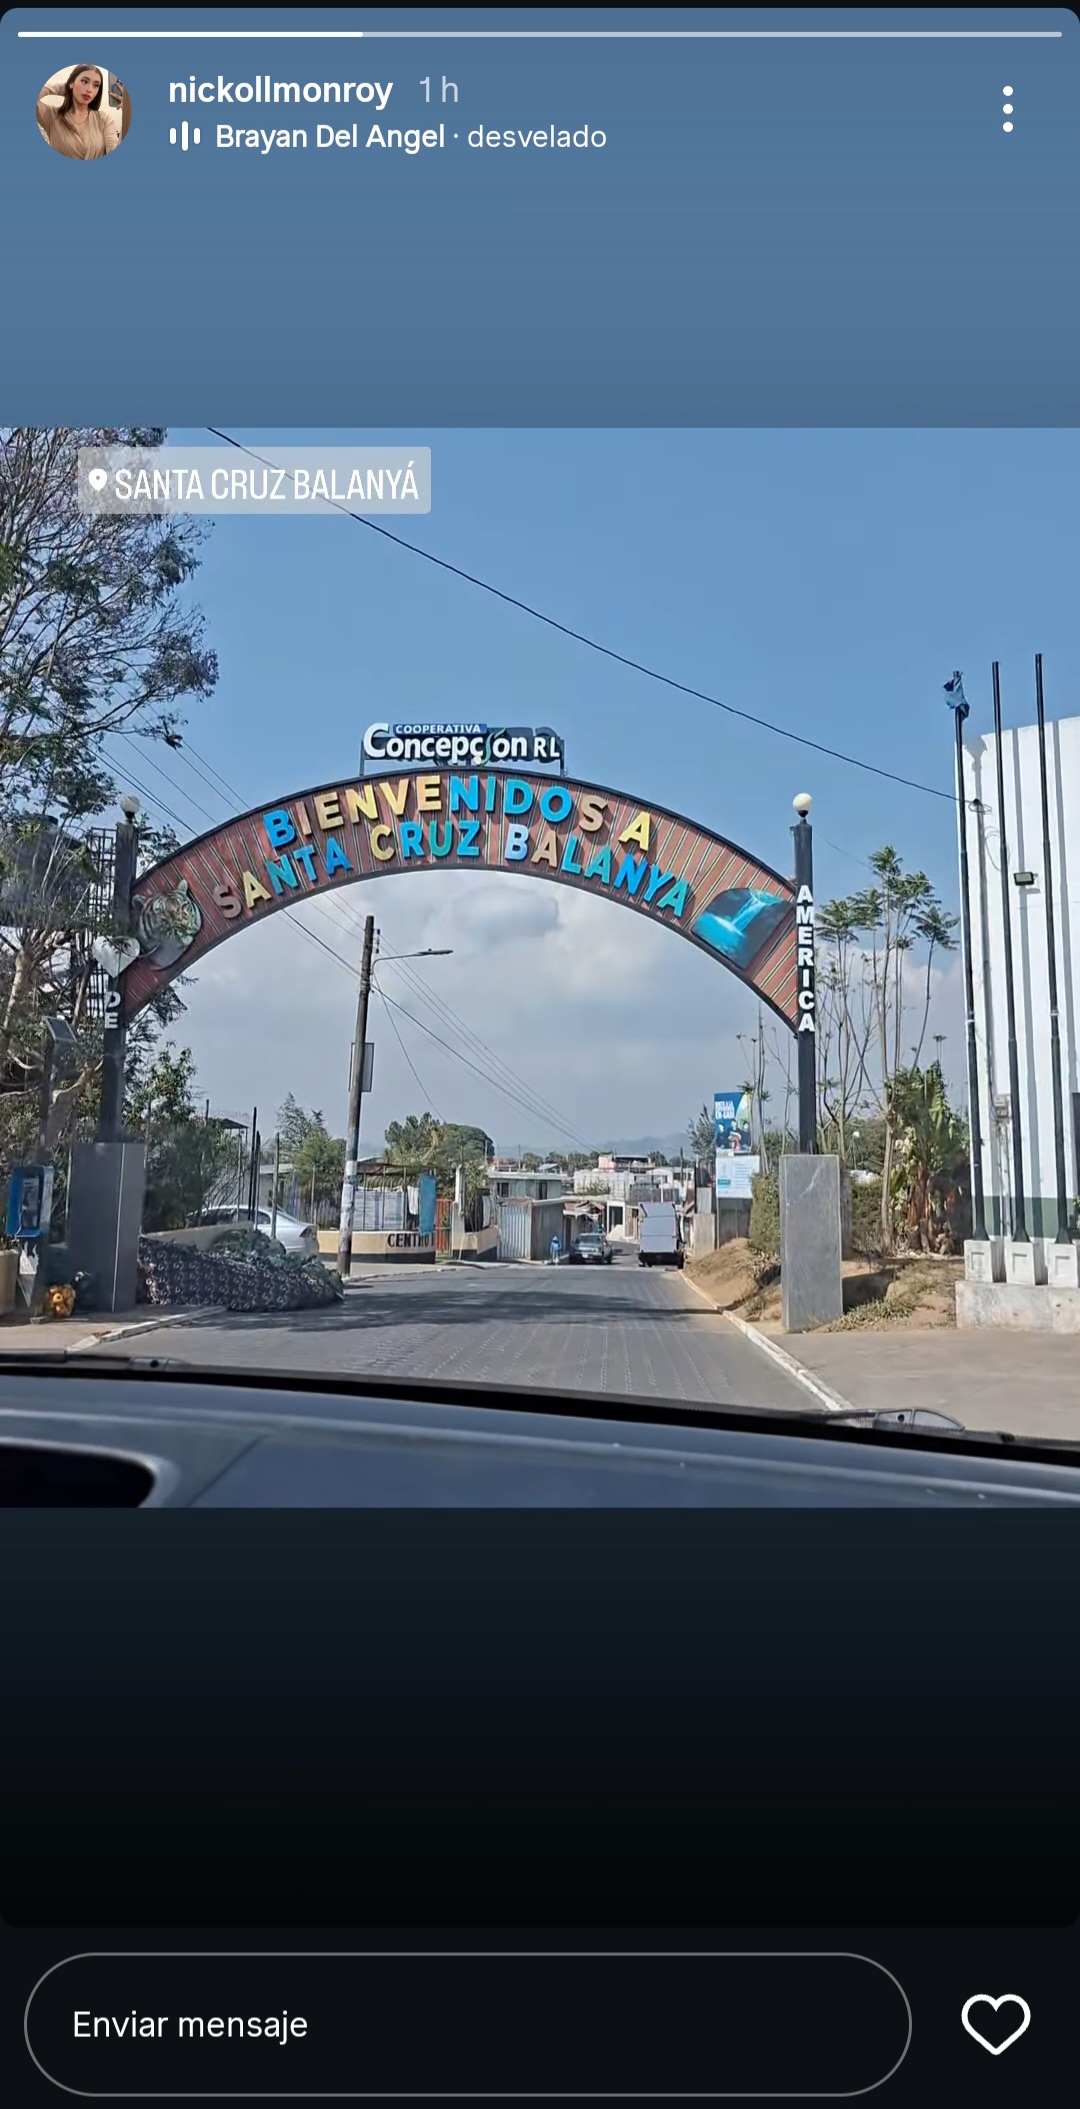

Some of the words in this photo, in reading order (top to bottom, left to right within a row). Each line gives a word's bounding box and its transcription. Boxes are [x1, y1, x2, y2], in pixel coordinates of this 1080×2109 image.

[395, 724, 482, 735] COOPERATIVA
[263, 775, 608, 849] BIENVENIDOS
[618, 811, 651, 852] A
[212, 836, 353, 919] SANTA
[370, 820, 480, 861] CRUZ
[505, 823, 690, 918] BALANYA
[796, 884, 815, 1032] AMERICA
[104, 990, 121, 1029] DE
